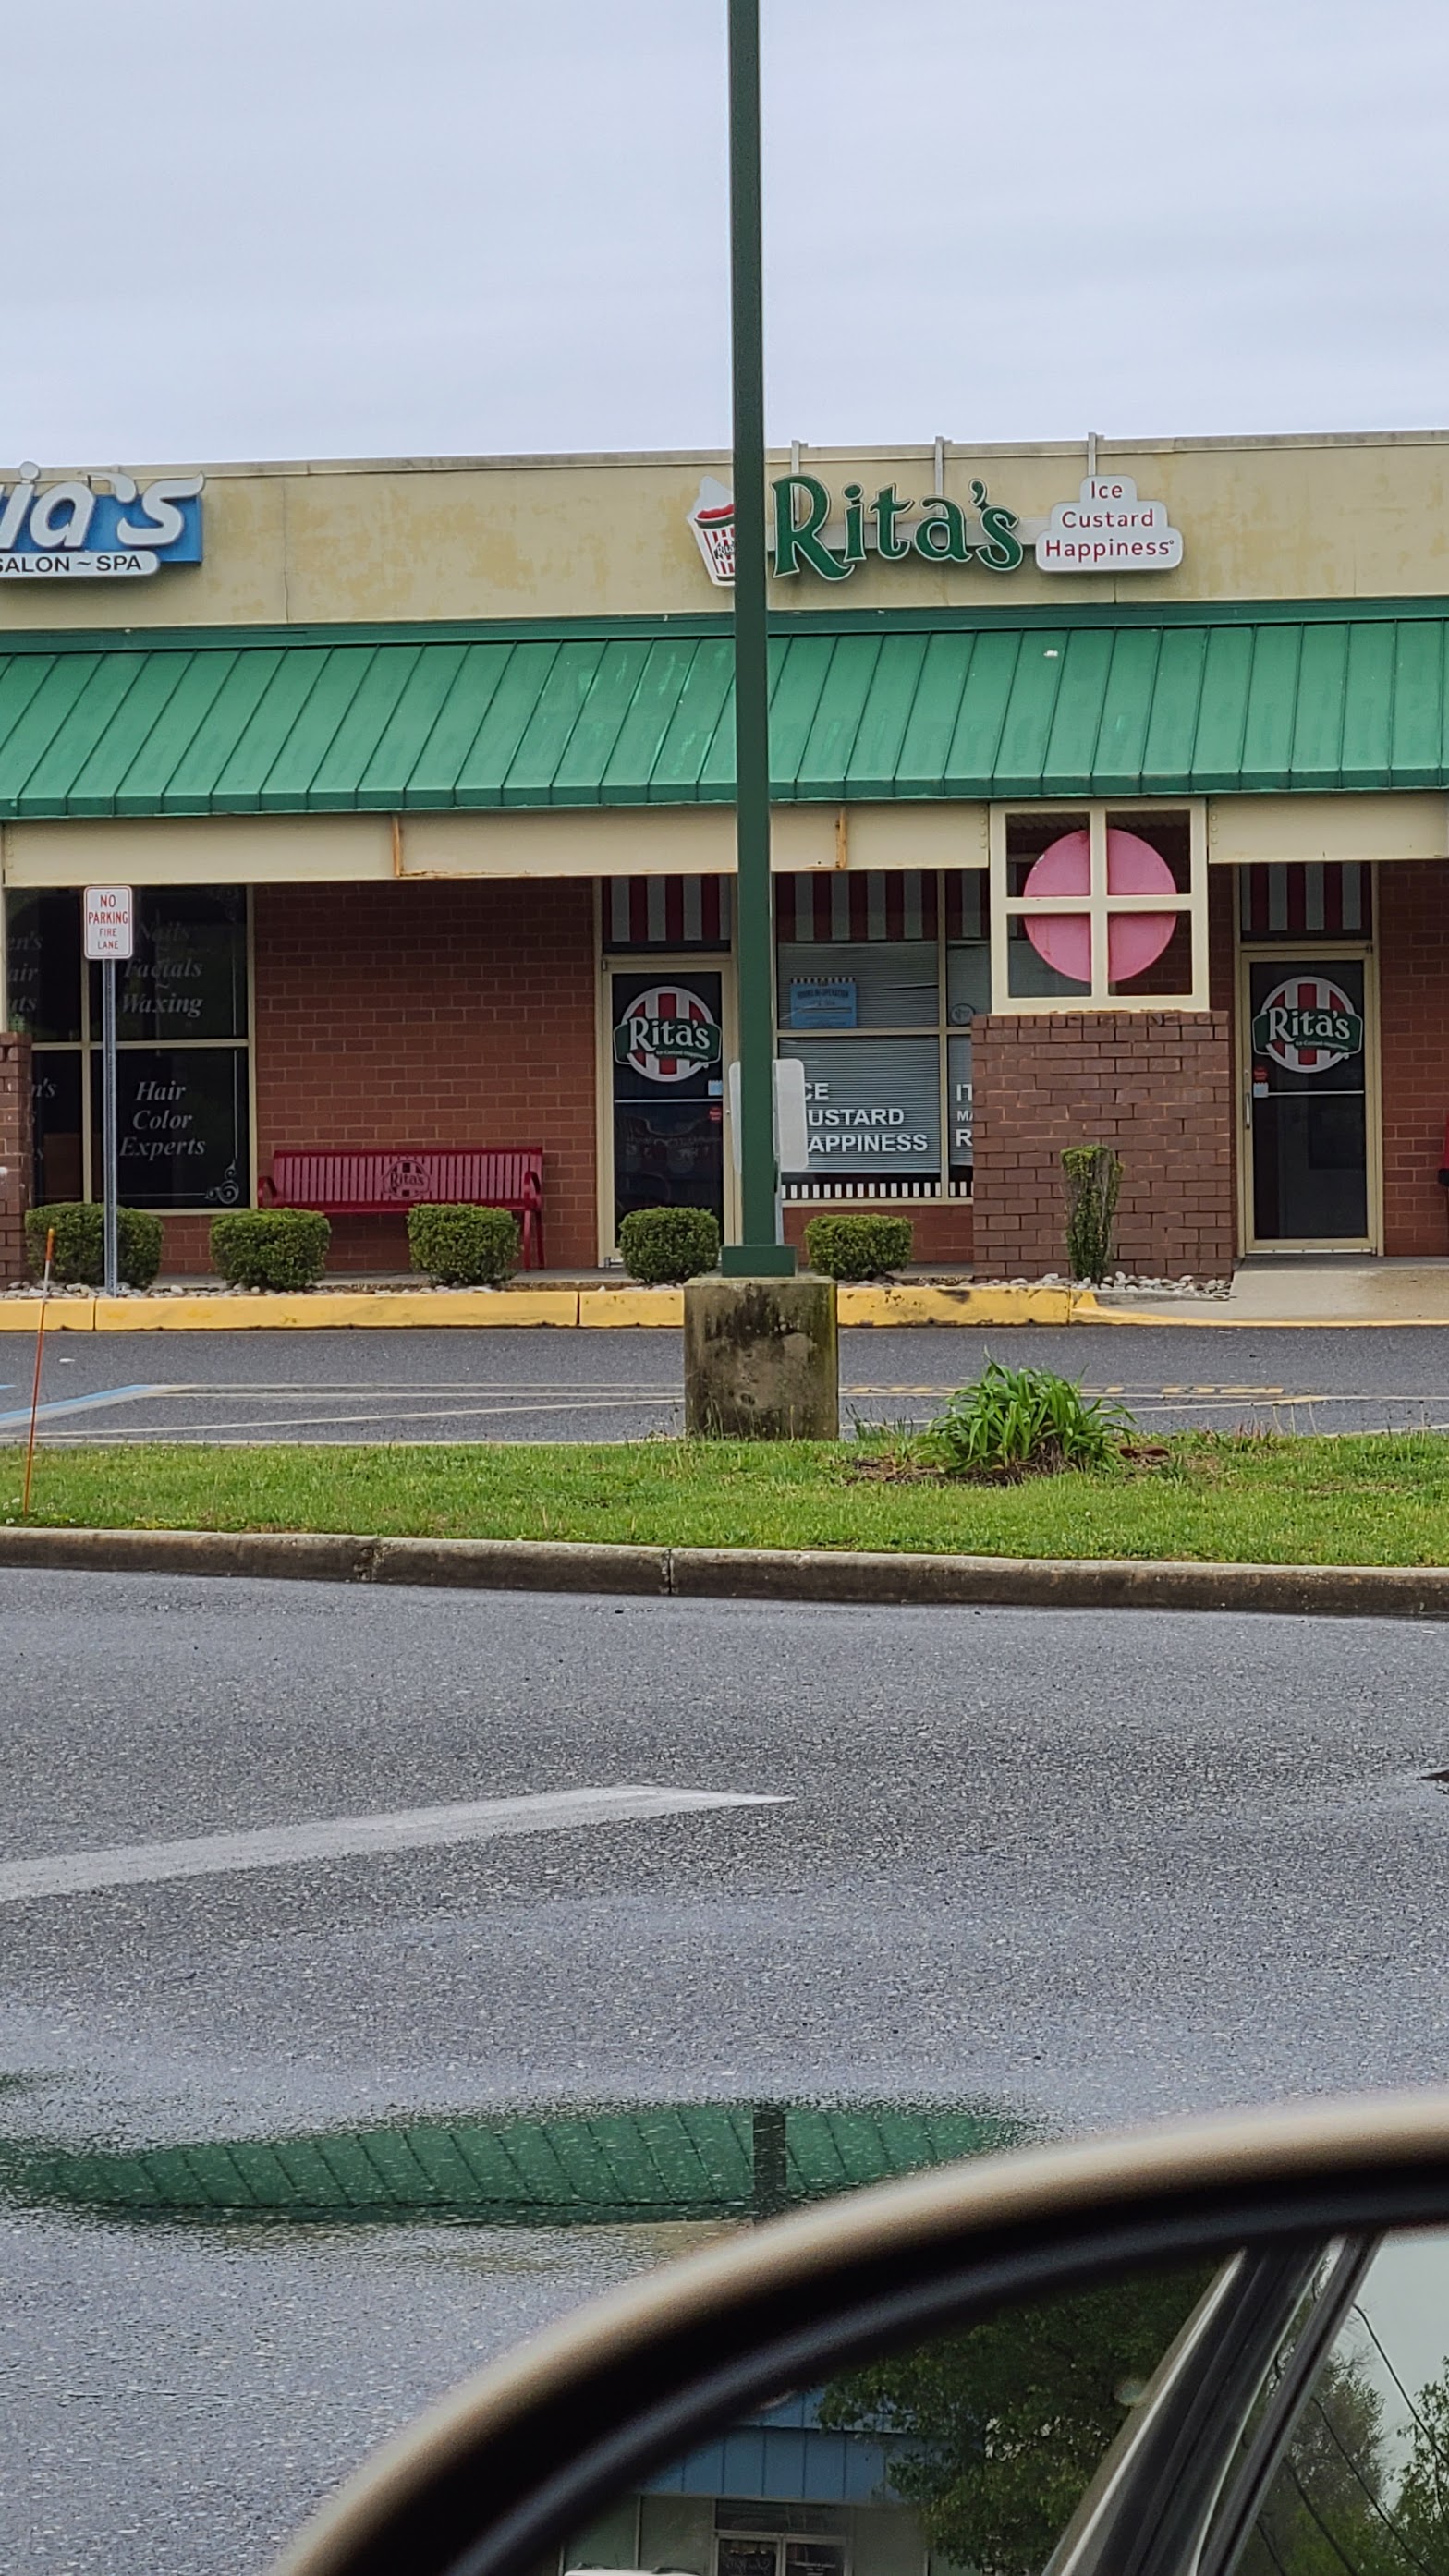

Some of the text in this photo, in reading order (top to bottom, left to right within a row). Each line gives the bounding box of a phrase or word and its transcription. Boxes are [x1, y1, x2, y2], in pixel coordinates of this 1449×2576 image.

[1090, 480, 1123, 500] Ice
[0, 461, 205, 549] ia's
[771, 472, 1024, 581] Rita's
[1062, 508, 1153, 528] Custard
[1045, 538, 1170, 563] Happiness
[0, 555, 142, 573] ALON SPA
[100, 894, 116, 908] NO
[89, 911, 128, 925] PARKING
[99, 928, 117, 937] FIRE
[97, 940, 119, 950] LANE
[124, 957, 203, 978] Facials
[121, 992, 203, 1018] Waxing
[629, 1016, 710, 1051] Rita's
[1269, 1007, 1350, 1042] Rita's
[136, 1080, 187, 1100] Hair
[804, 1082, 830, 1100] CE
[132, 1109, 193, 1130] Color
[808, 1108, 905, 1126] USTARD
[119, 1137, 206, 1161] Experts
[808, 1134, 928, 1153] APPINESS
[390, 1172, 425, 1187] Rita's
